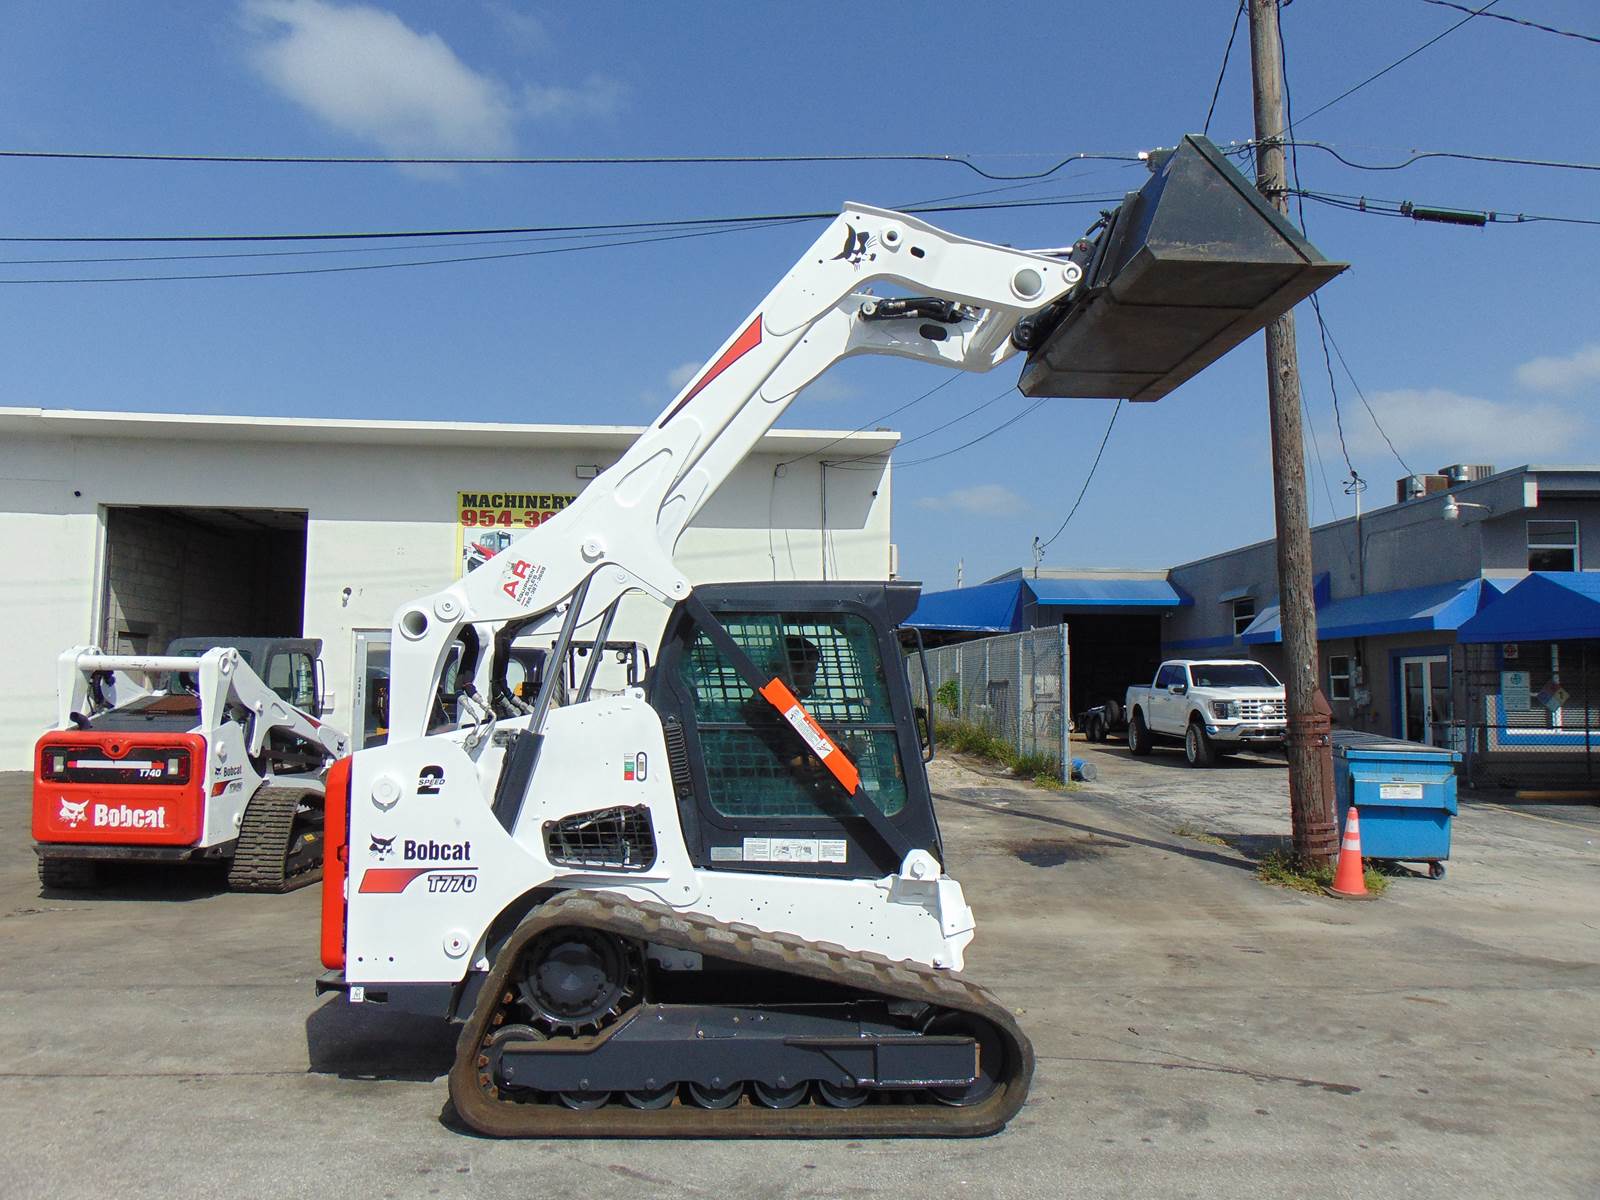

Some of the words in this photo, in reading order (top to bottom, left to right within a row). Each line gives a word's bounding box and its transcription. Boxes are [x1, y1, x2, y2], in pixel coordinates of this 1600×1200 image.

[503, 560, 532, 600] AR
[516, 565, 537, 603] EQUIPMENT
[524, 574, 538, 597] SALES
[139, 769, 162, 777] T740
[417, 765, 444, 795] 2
[94, 803, 166, 828] Bobcat
[404, 840, 471, 861] Bobcat
[427, 875, 478, 893] T770
